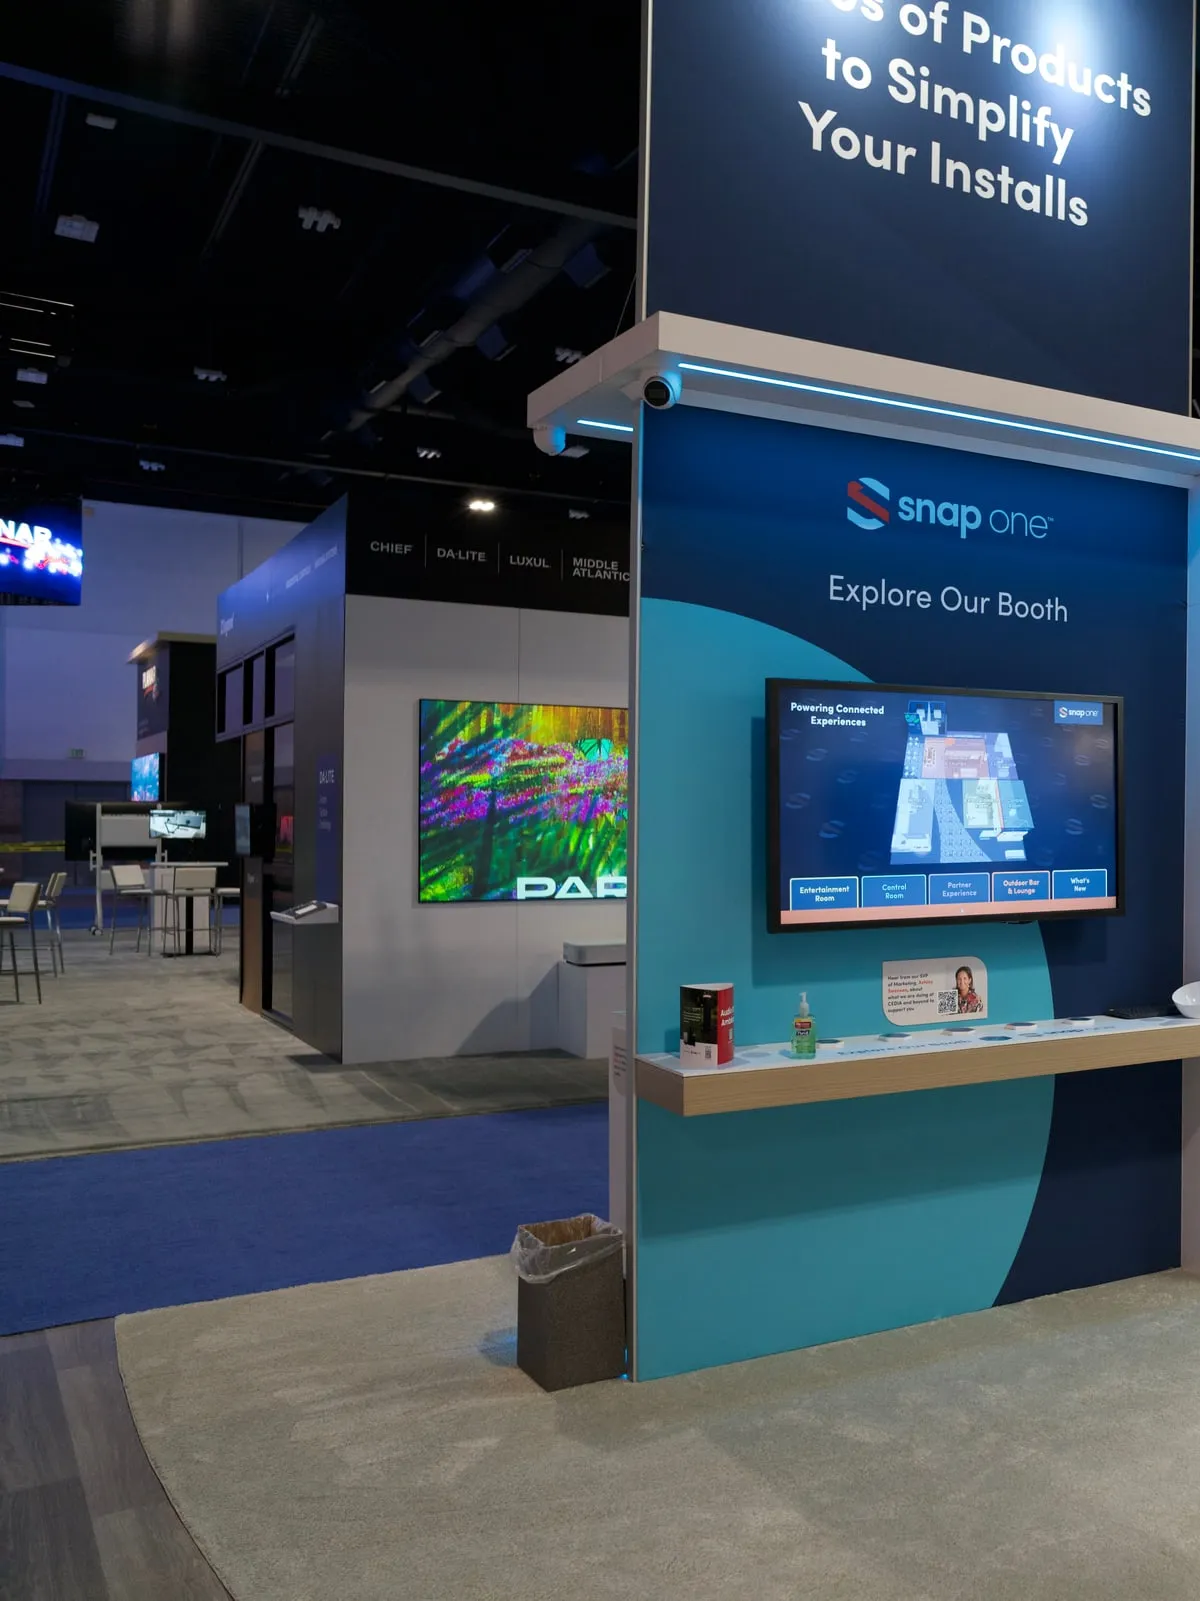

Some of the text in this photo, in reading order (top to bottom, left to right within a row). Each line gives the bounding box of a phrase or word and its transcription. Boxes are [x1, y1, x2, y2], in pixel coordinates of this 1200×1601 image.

[899, 1, 950, 44] of
[962, 11, 1152, 117] Products
[821, 38, 1074, 166] to Simplify
[798, 101, 1089, 227] Your Installs
[898, 496, 982, 539] snap
[370, 541, 413, 554] CHIEF
[509, 555, 550, 568] LUXUL
[572, 557, 619, 571] MIDDLE
[572, 567, 631, 582] ATLANTIC
[829, 574, 1069, 622] Explore Our Booth
[790, 702, 885, 716] Powering Connected
[810, 716, 867, 727] Experiences
[882, 883, 907, 891] Control
[947, 881, 972, 889] Partner
[1002, 879, 1028, 887] Outdoor
[1070, 877, 1091, 885] What's
[799, 885, 850, 894] Entertainment
[942, 890, 978, 898] Experience
